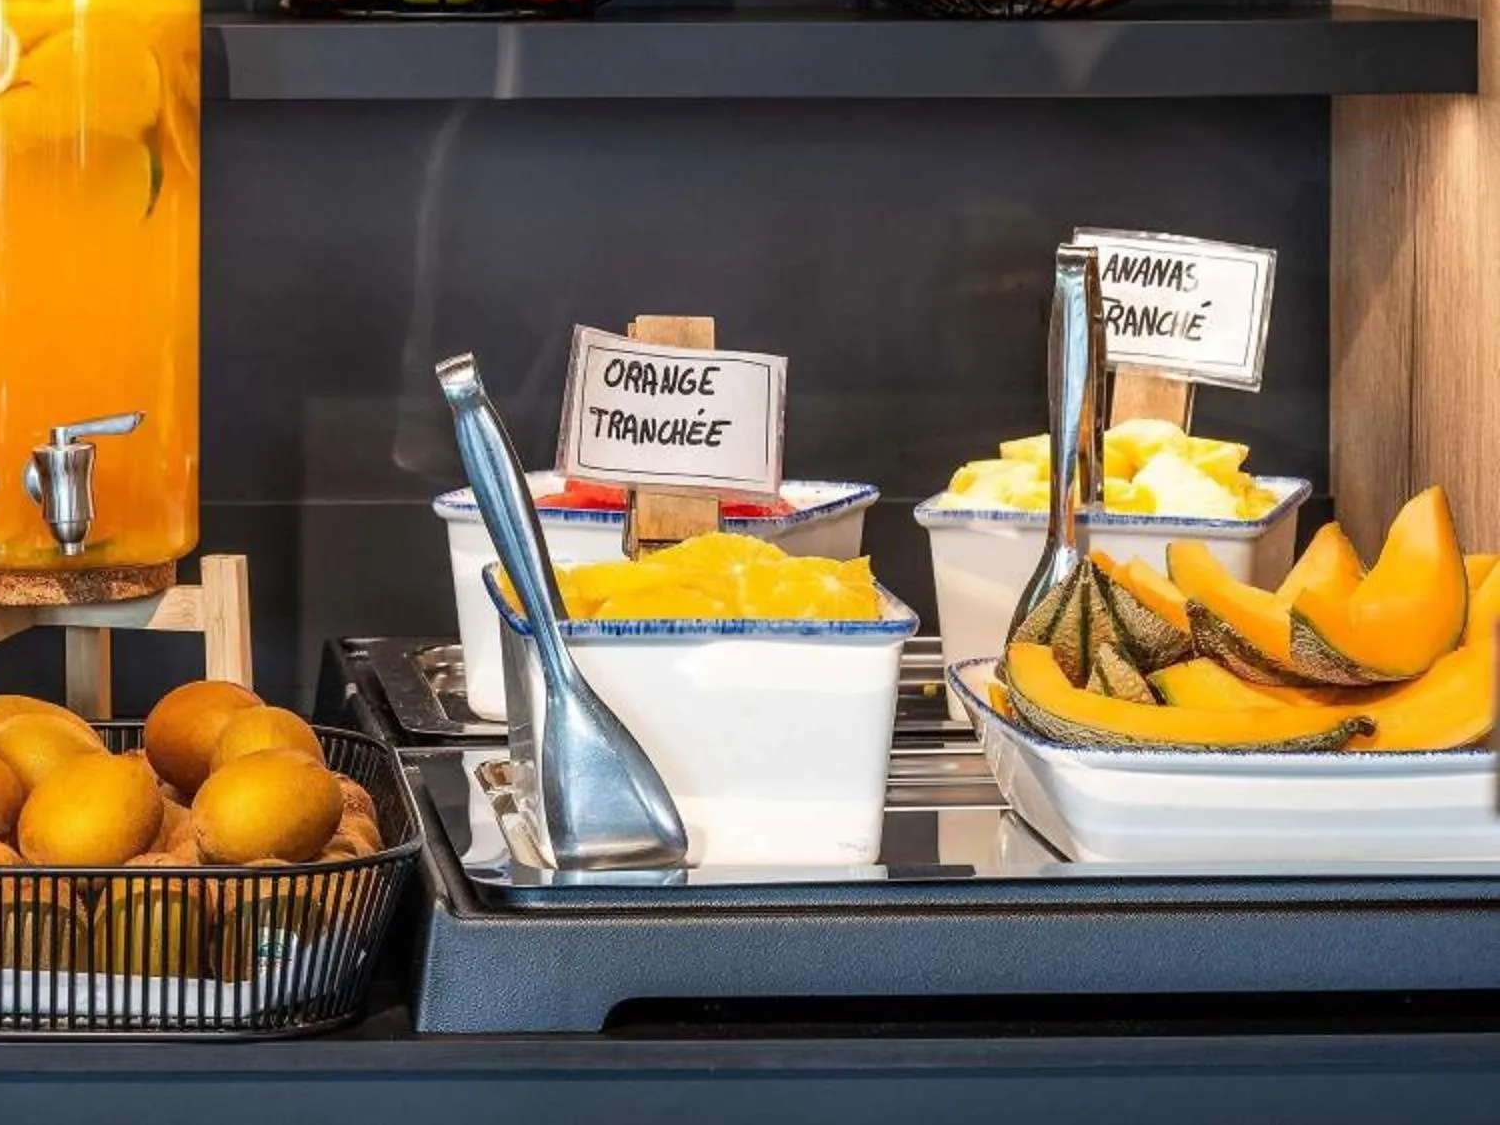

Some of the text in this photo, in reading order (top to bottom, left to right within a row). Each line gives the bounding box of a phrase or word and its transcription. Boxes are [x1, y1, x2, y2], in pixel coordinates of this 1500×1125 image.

[1102, 253, 1199, 292] ANANAS
[603, 358, 721, 396] ORANGE
[589, 407, 733, 448] TRANCHÉE
